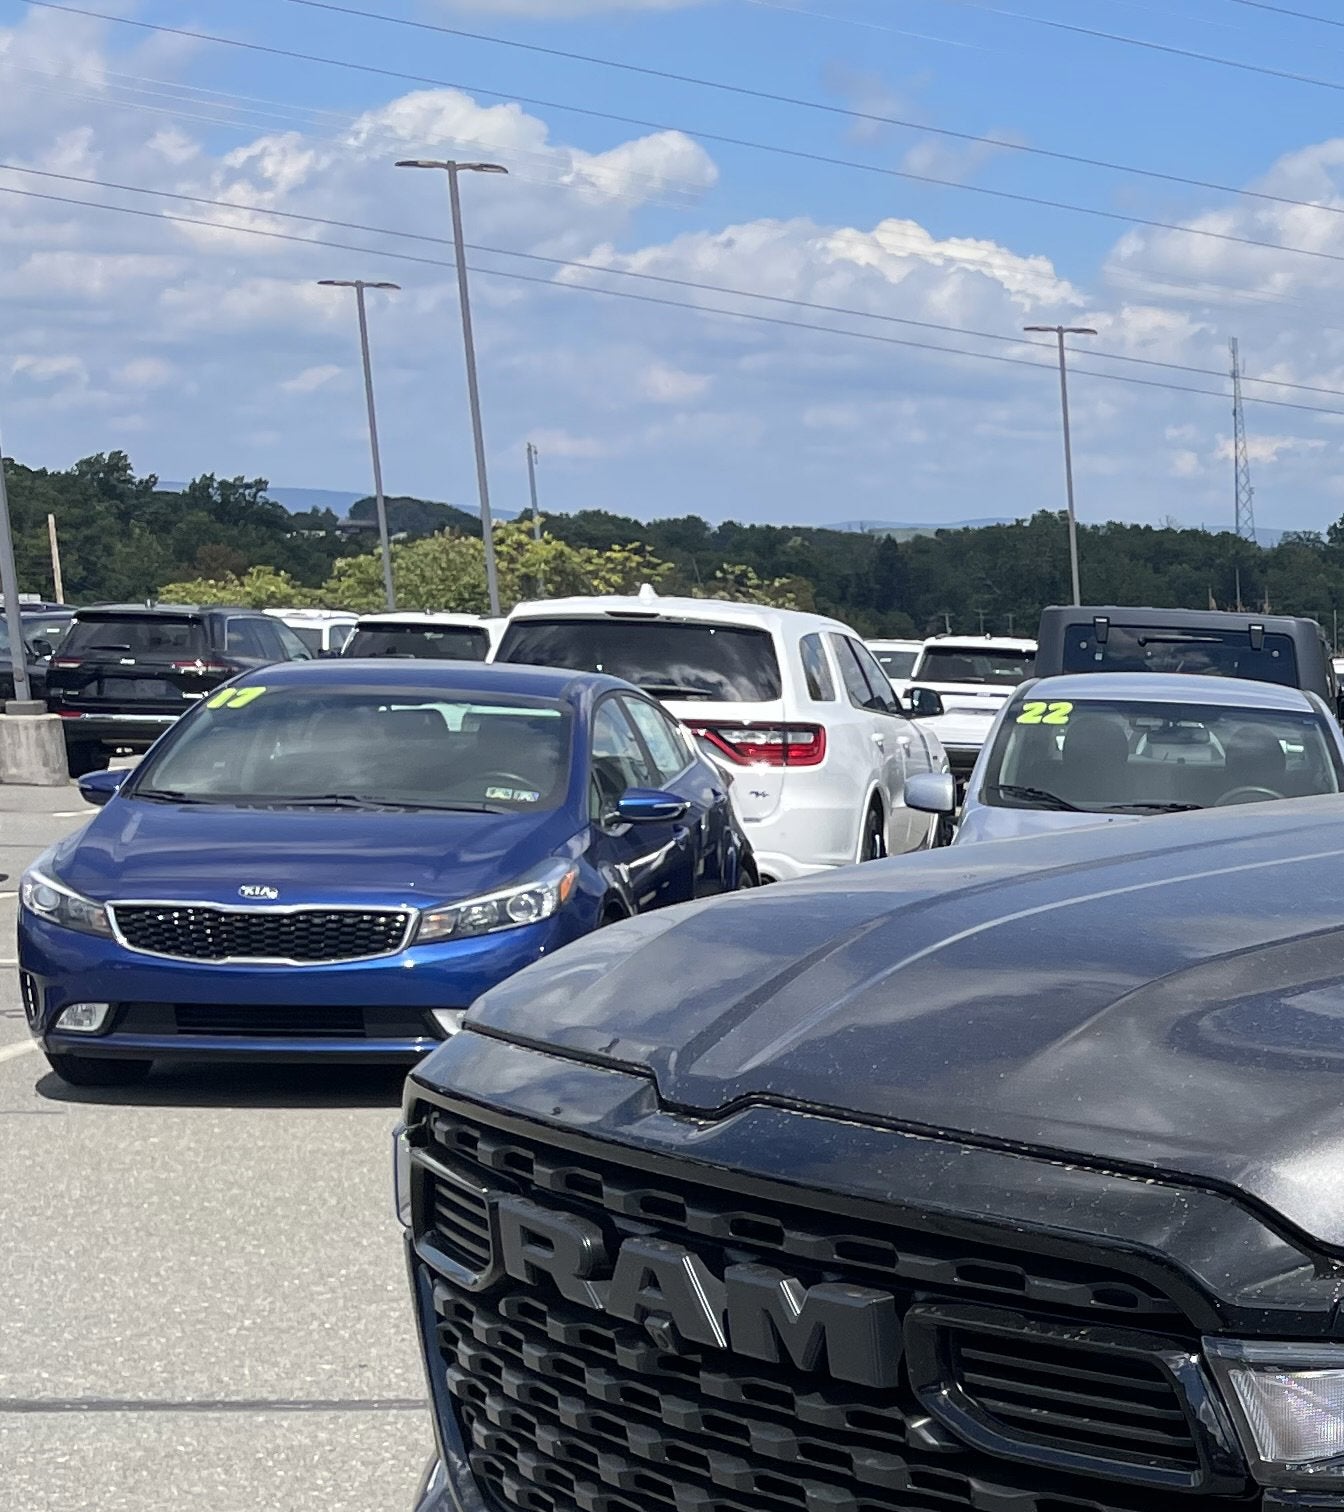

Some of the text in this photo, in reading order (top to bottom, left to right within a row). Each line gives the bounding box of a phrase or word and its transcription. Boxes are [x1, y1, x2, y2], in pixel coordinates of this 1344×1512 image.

[206, 686, 267, 709] 17
[1016, 701, 1073, 724] 22
[498, 1195, 901, 1388] RAM
